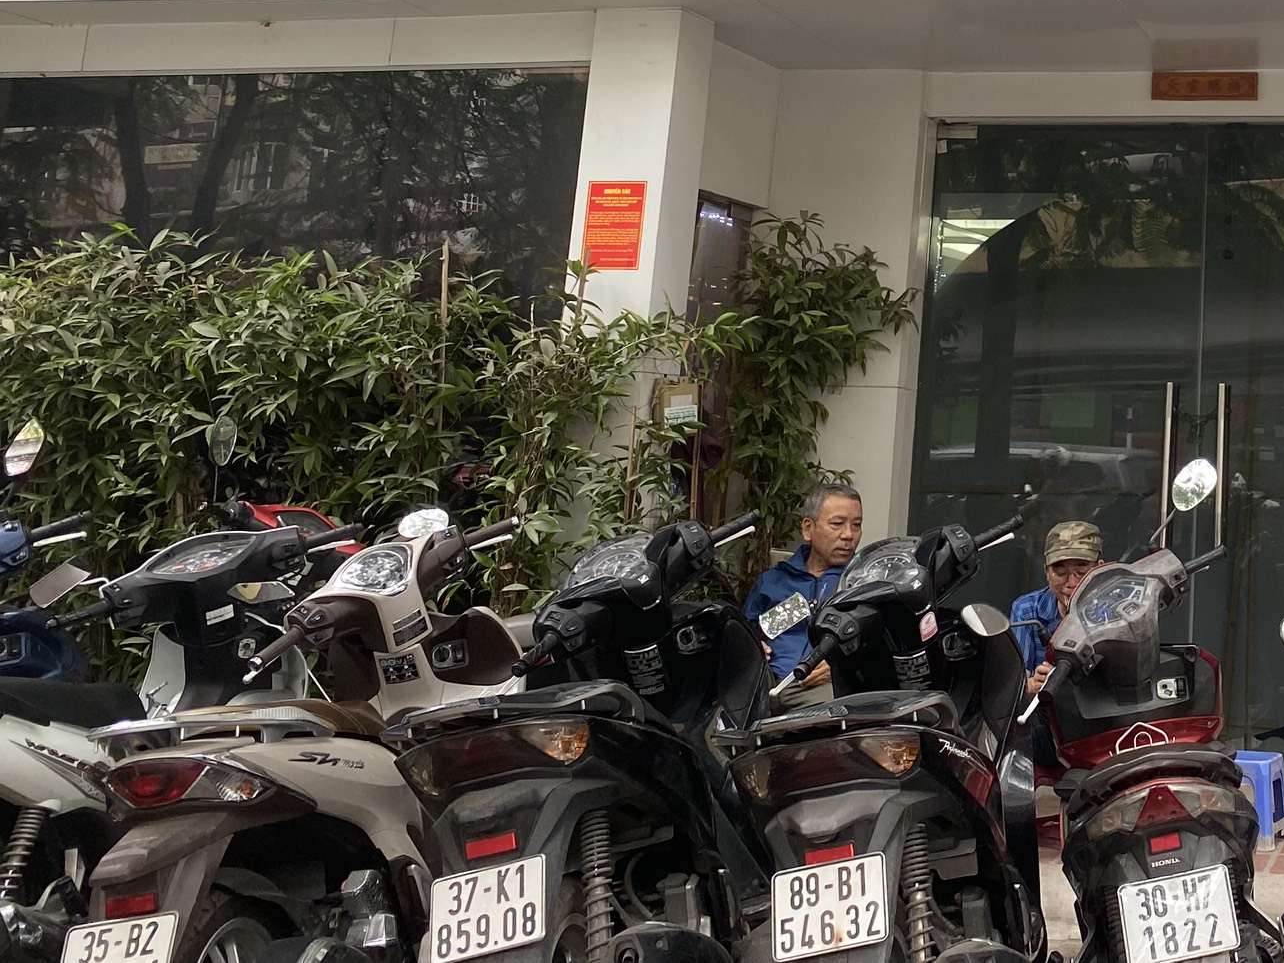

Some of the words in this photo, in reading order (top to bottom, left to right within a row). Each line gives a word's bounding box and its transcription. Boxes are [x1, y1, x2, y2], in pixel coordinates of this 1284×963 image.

[448, 864, 525, 916] 37-K1
[789, 862, 866, 911] 89-B1
[79, 921, 159, 963] 35-B2
[437, 902, 537, 959] 859.08
[780, 900, 881, 954] 546.32
[1142, 913, 1223, 960] 1822
